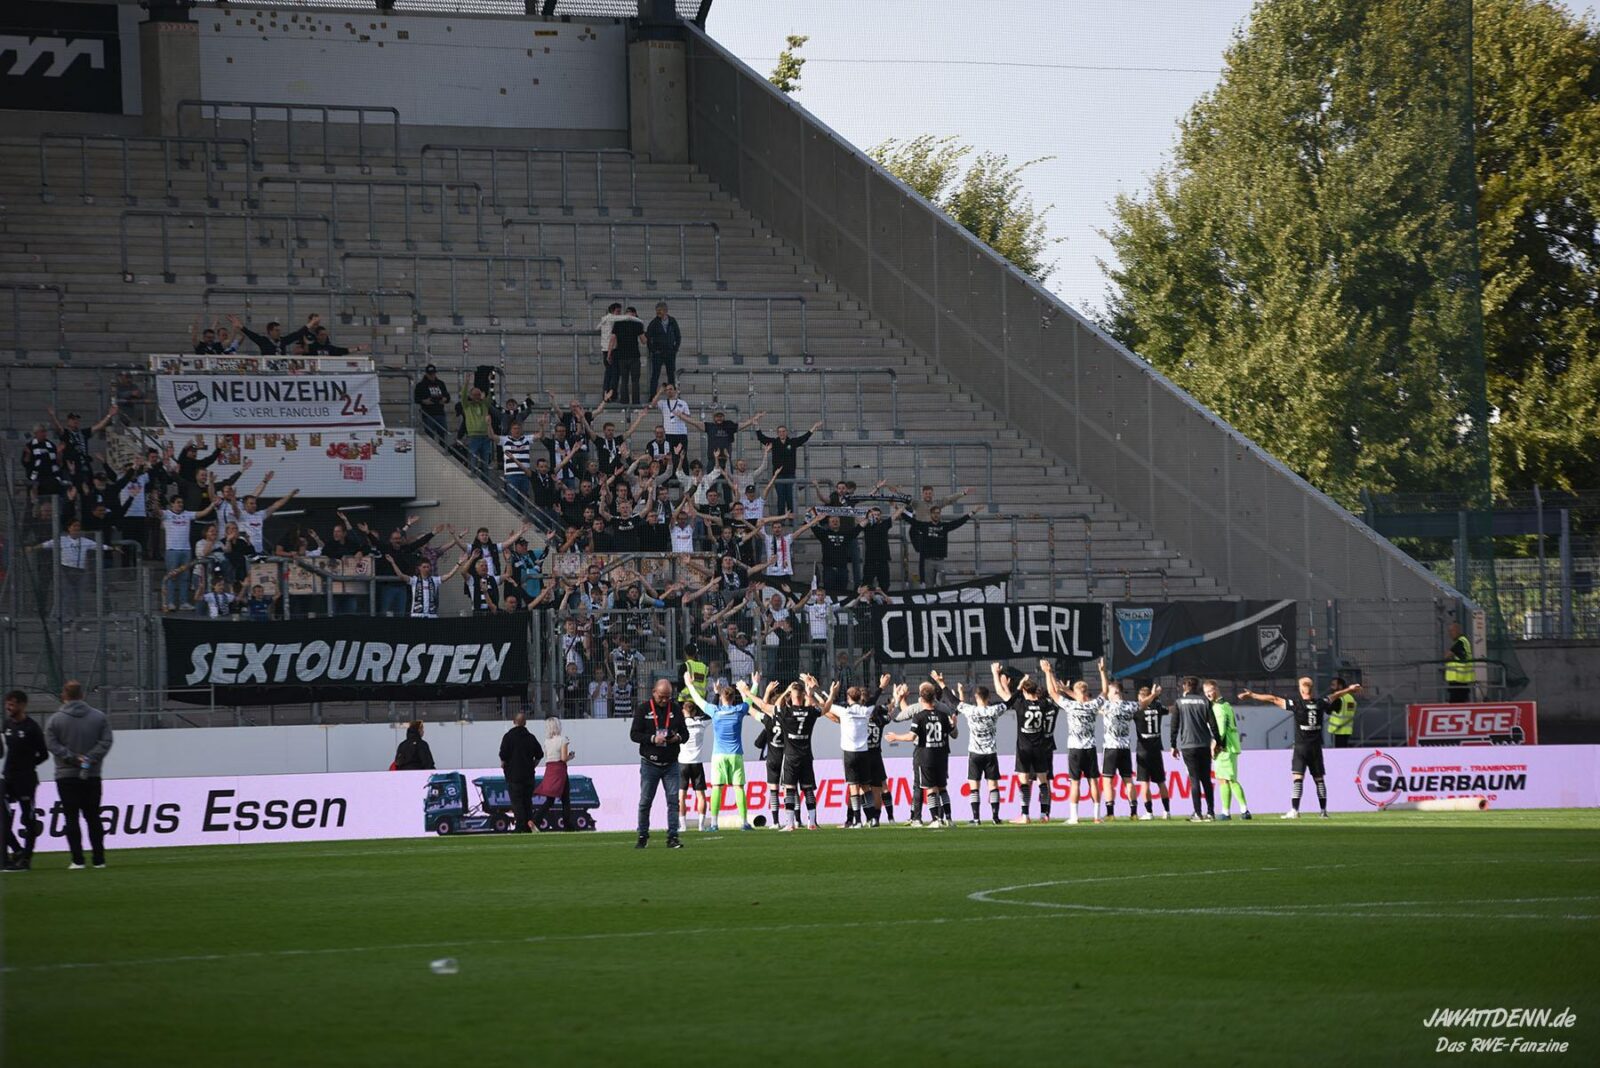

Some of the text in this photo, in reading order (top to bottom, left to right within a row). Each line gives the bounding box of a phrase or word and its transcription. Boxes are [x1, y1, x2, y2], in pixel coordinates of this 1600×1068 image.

[212, 380, 347, 403] NEUNZEHN
[233, 407, 330, 418] SC VERL FANCLUB
[341, 393, 368, 416] 24
[881, 605, 1093, 659] CURIA VERL
[1261, 630, 1277, 639] SCV
[185, 639, 511, 686] SEXTOURISTEN
[796, 717, 806, 735] 7
[1024, 710, 1043, 729] 23
[1144, 715, 1159, 733] 11
[926, 721, 942, 743] 28
[1367, 765, 1527, 792] SAUERBAUM
[1411, 764, 1527, 773] BAUSTOFFE TRANSPORTE
[202, 789, 347, 833] Essen
